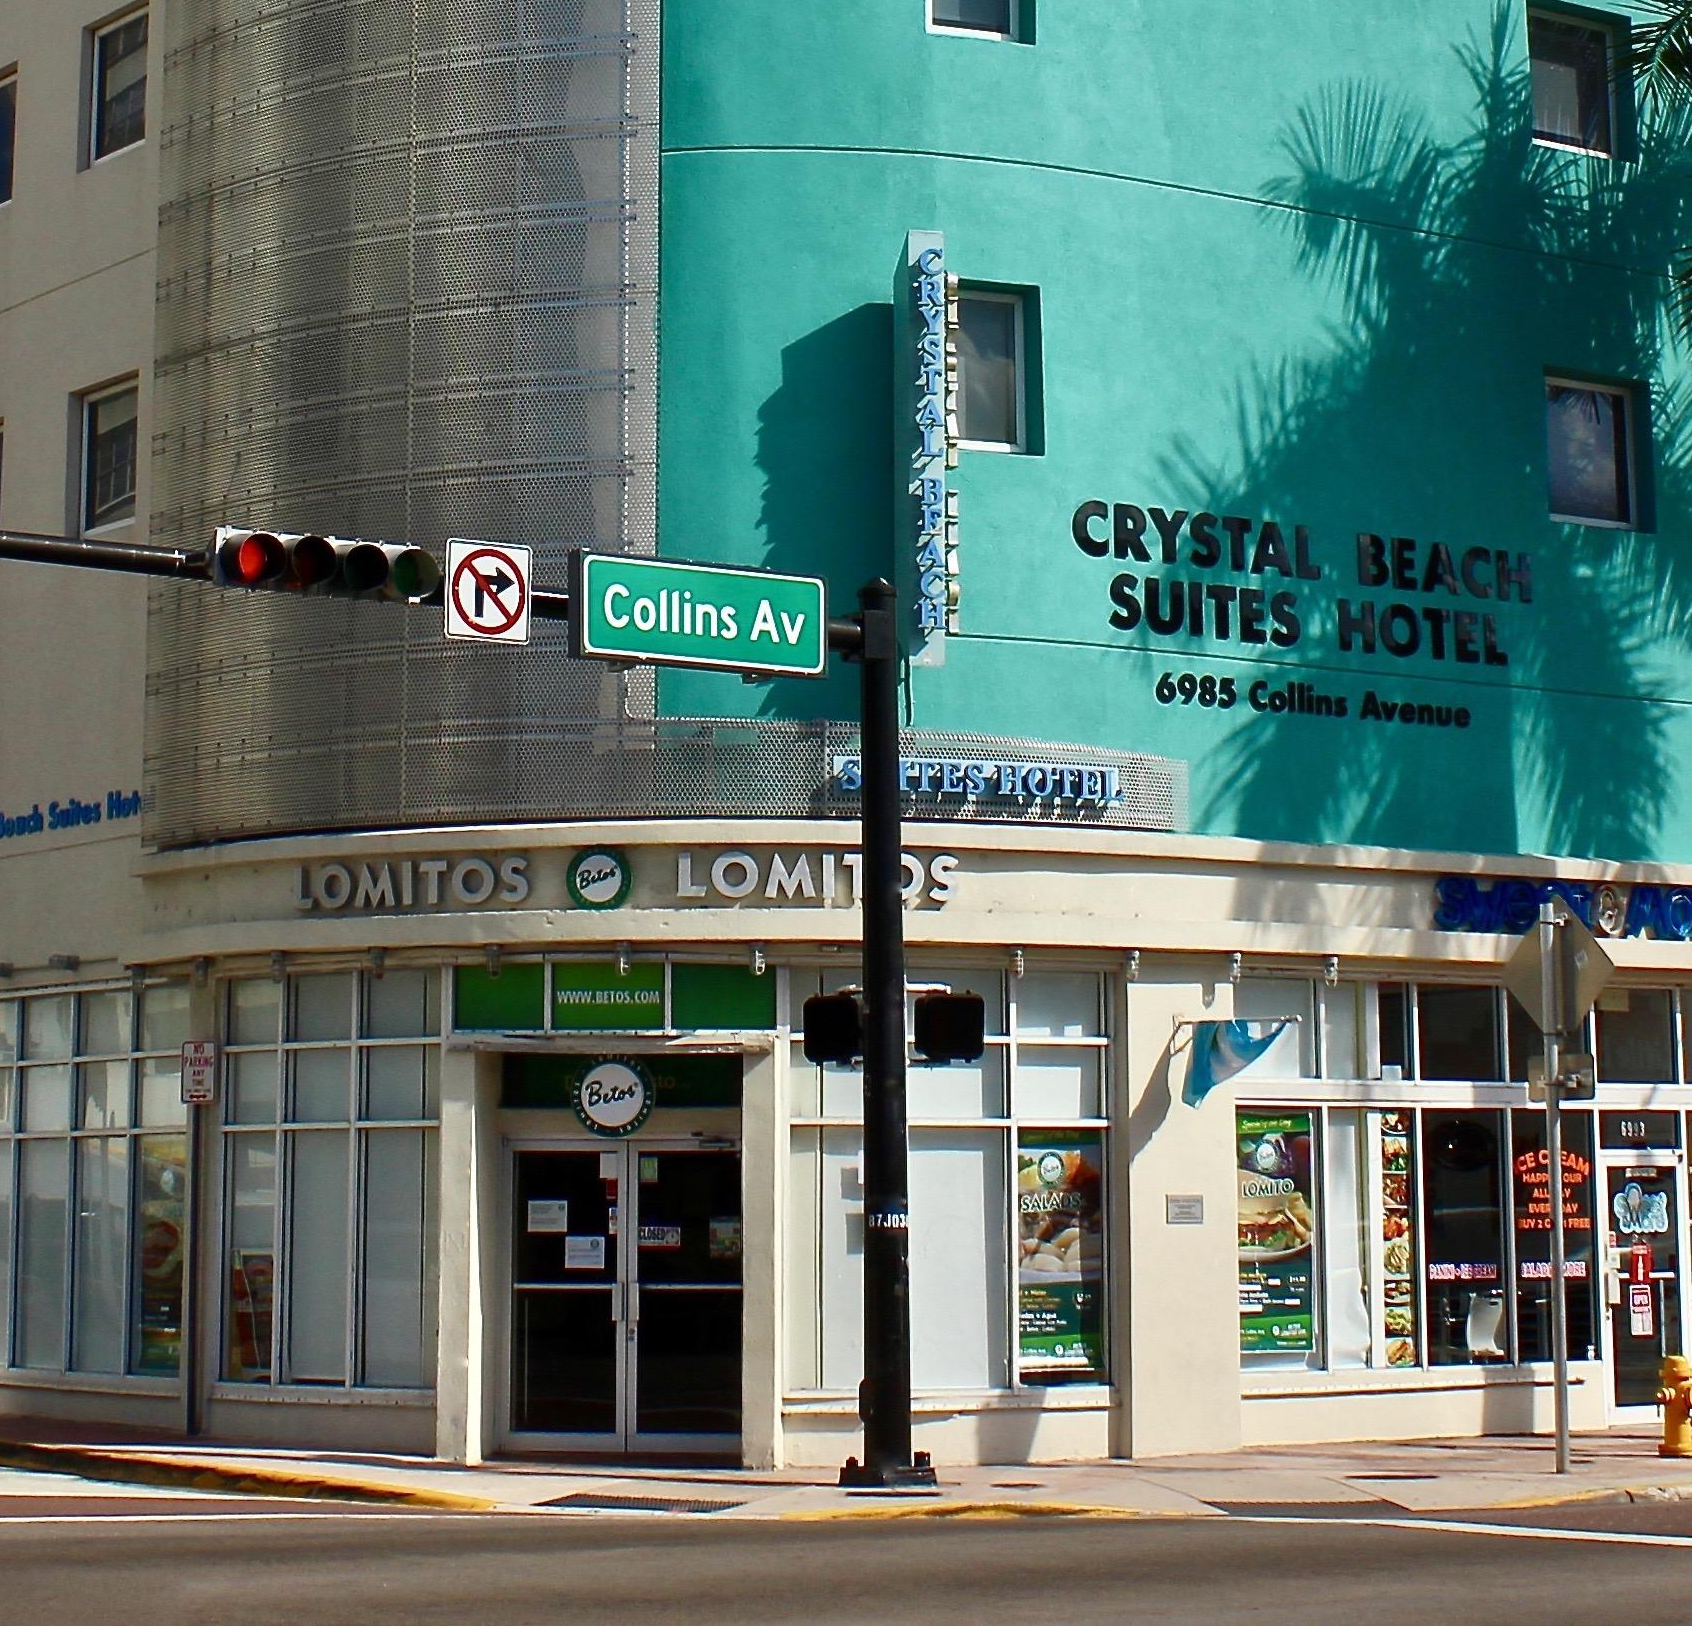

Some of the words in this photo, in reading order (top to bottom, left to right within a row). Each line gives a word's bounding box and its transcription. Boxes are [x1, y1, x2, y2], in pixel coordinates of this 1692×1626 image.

[918, 248, 944, 457] CRYSTAL
[919, 478, 946, 629] BEACH
[1071, 499, 1321, 580] CRYSTAL
[1356, 532, 1534, 604] BEACH
[603, 582, 738, 640] Collins
[749, 599, 805, 645] Av
[1108, 573, 1302, 648] SUITES
[1337, 597, 1509, 666] HOTEL
[1154, 672, 1237, 710] 6985
[1248, 680, 1348, 718] Collins
[1359, 690, 1471, 728] Avenue
[840, 759, 985, 795] SITES
[994, 764, 1125, 801] HOTEL
[48, 798, 102, 830] Suites
[106, 789, 142, 820] Hot
[294, 856, 529, 910] LOMITOS
[557, 990, 660, 1005] WWW.BETOS.COM
[193, 1043, 205, 1055] NO
[584, 1080, 637, 1108] Betos
[1522, 1172, 1550, 1183] HAPP
[1562, 1172, 1583, 1183] OUR
[1538, 1149, 1590, 1176] CEAM
[1020, 1191, 1082, 1214] SALADS
[1241, 1177, 1295, 1199] LOMITO
[1568, 1218, 1591, 1229] FREE
